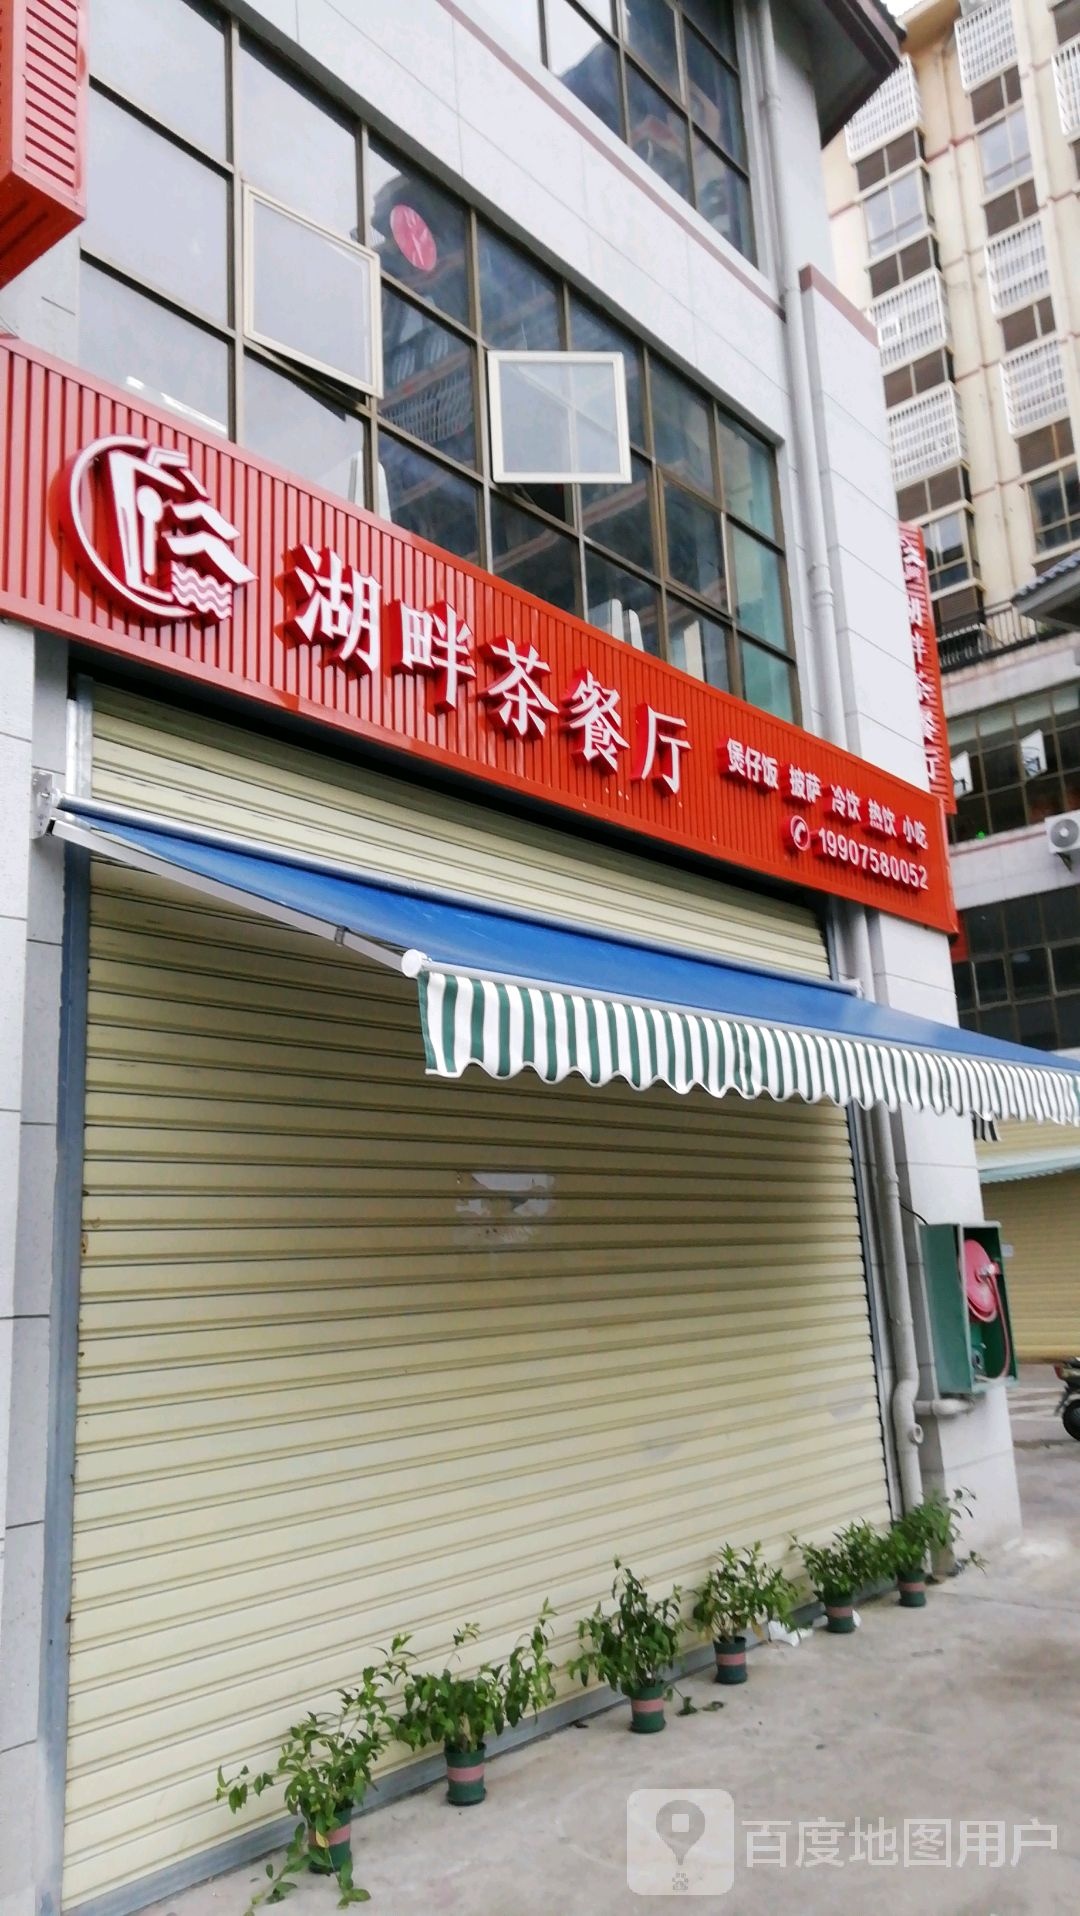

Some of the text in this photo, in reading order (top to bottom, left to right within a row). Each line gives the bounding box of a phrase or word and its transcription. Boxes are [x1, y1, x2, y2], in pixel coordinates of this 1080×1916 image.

[294, 543, 692, 794] 湖畔茶餐厅
[727, 738, 928, 849] 煲仔饭 披萨 冷饮 热饮 小吃
[818, 827, 929, 890] 19907580052
